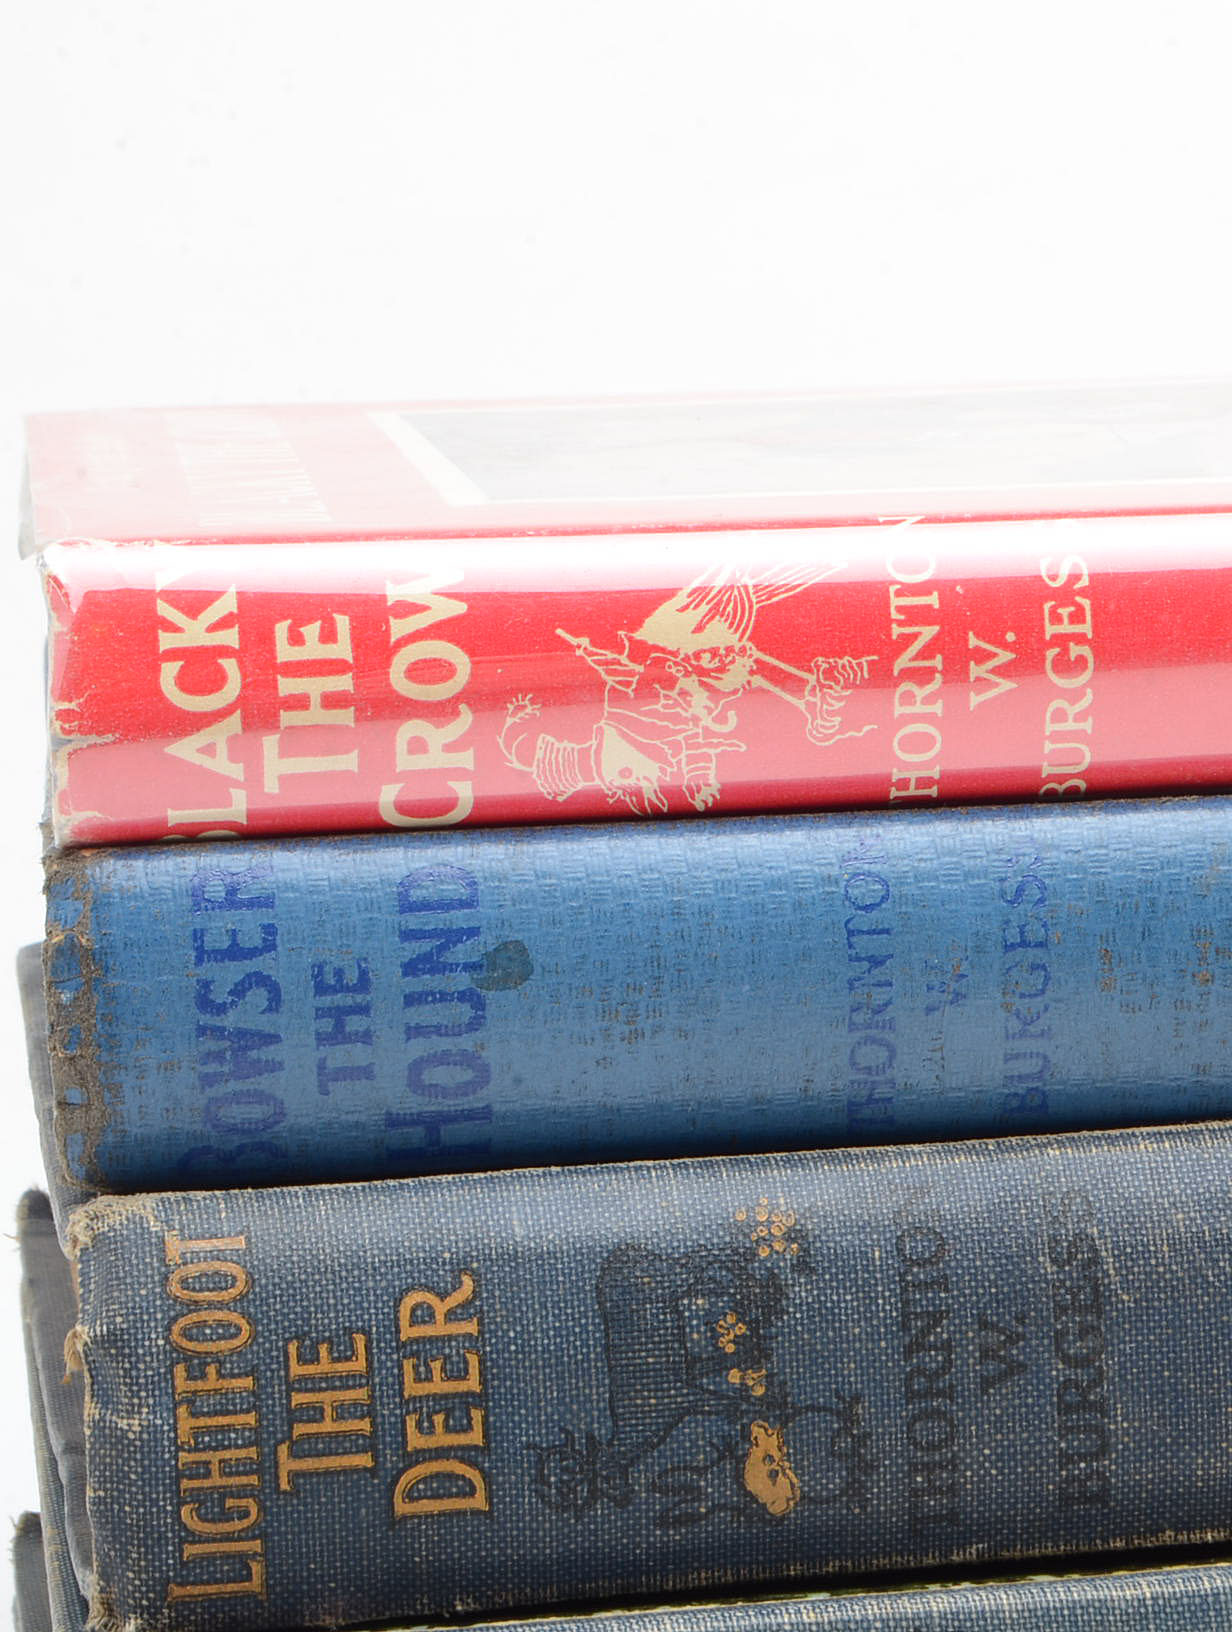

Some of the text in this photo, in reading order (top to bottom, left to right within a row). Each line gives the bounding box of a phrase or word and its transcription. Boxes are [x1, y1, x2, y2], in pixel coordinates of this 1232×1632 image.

[155, 567, 247, 840] LACK
[263, 613, 358, 793] THE
[378, 568, 475, 828] CROW
[879, 516, 942, 800] HORNTO
[968, 632, 1019, 711] W.
[1039, 525, 1093, 799] BURGES
[178, 861, 287, 1176] BOWSER
[310, 956, 376, 1096] THE
[386, 863, 493, 1163] HOUND
[164, 1229, 267, 1604] LIGHTFOOT
[276, 1332, 375, 1493] THE
[392, 1270, 491, 1519] DEER
[976, 1311, 1029, 1397] W.
